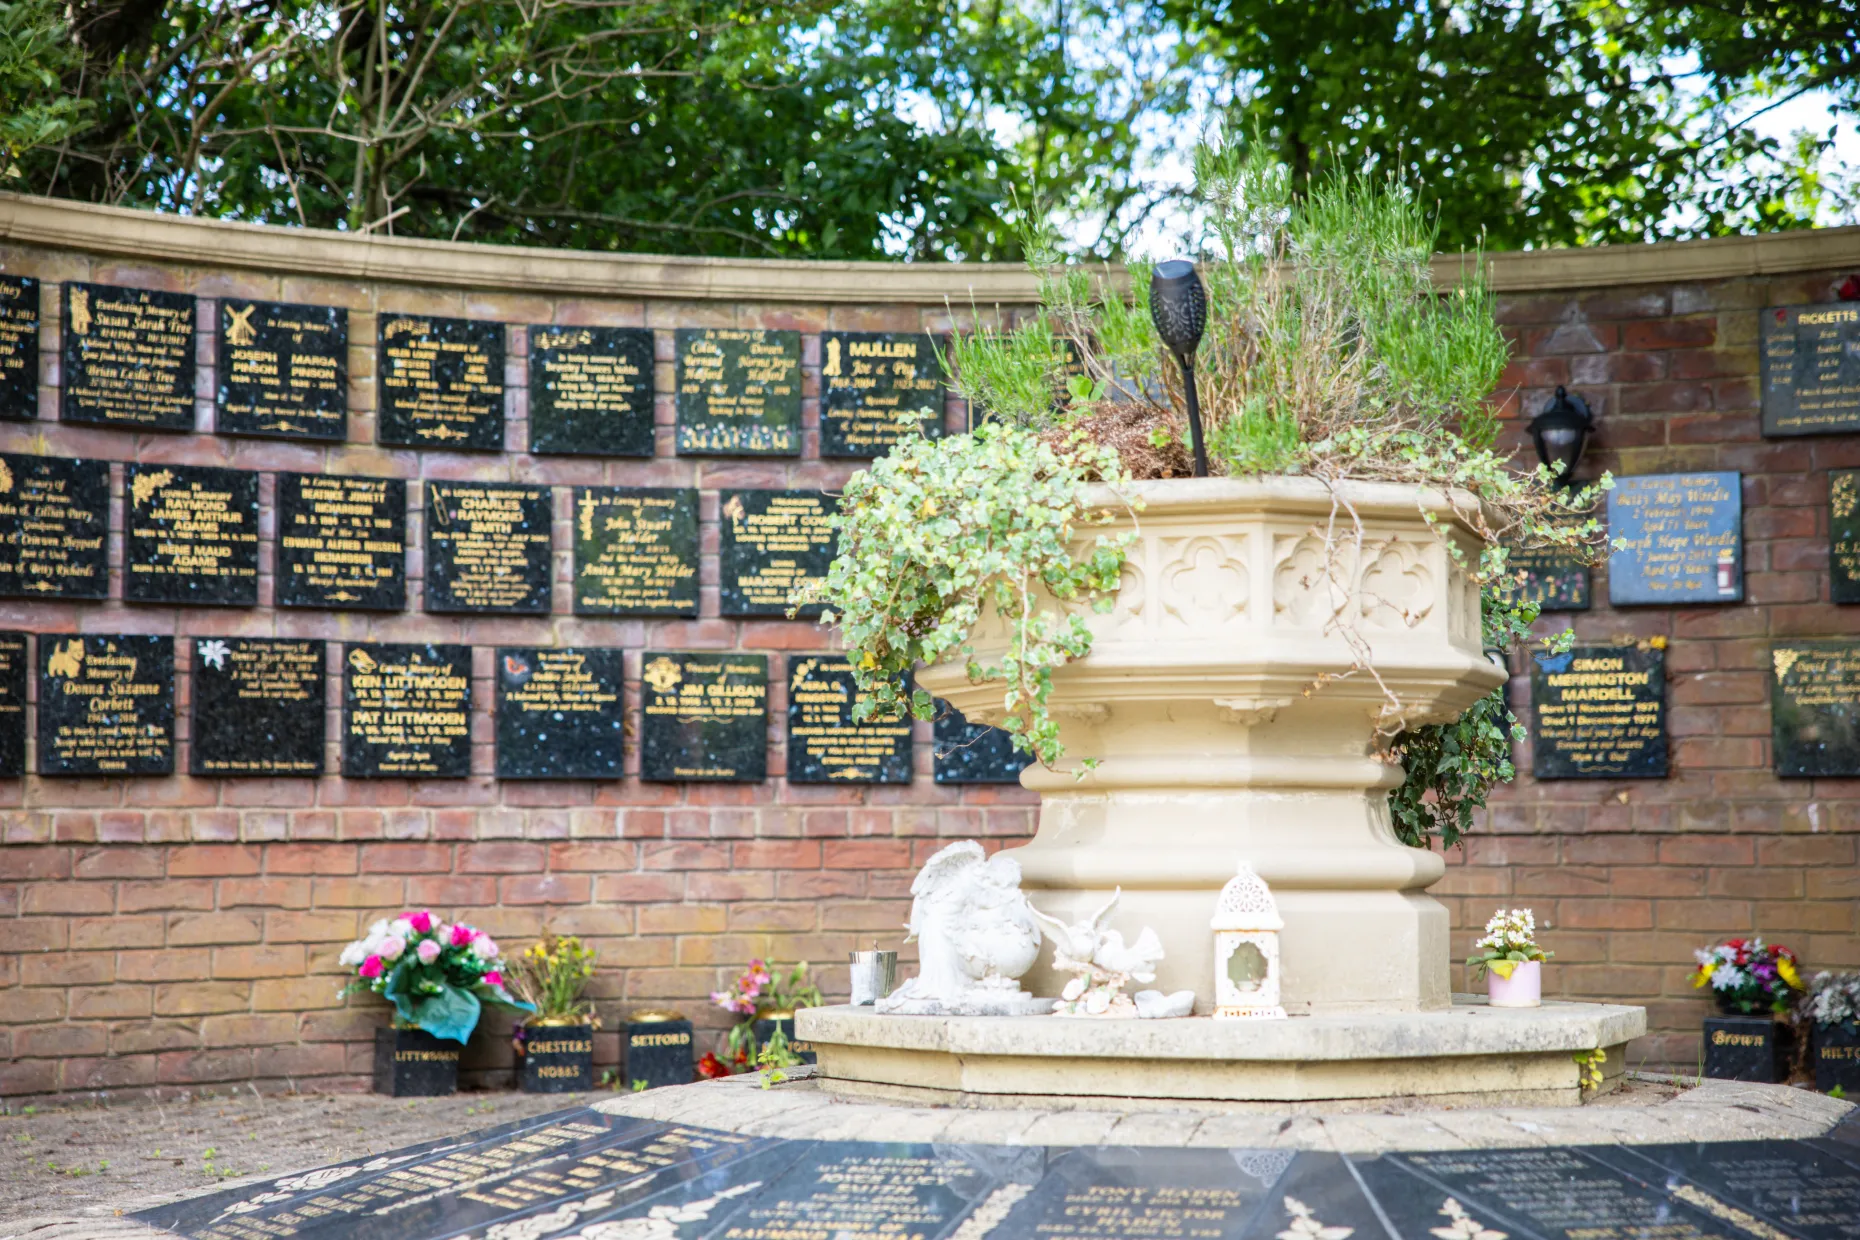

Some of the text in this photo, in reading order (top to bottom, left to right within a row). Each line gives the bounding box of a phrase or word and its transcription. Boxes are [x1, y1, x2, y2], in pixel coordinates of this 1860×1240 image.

[95, 299, 144, 316] Everlasting
[145, 304, 179, 319] Memory
[95, 312, 192, 334] Susan Sarah Tree
[1798, 310, 1858, 325] RICKETTS
[231, 349, 278, 363] JOSEPH
[849, 342, 917, 358] MULLEN
[233, 361, 278, 375] PINSON
[291, 366, 336, 380] PINSON
[850, 359, 873, 377] Joe
[152, 369, 176, 383] Tree
[193, 490, 233, 501] MEMORY
[1655, 491, 1682, 507] May
[1686, 487, 1730, 502] Wardle
[165, 498, 228, 511] RAYMOND
[314, 501, 374, 516] RICHARDSON
[461, 498, 521, 511] CHARLES
[149, 507, 243, 523] JAMES ARTHUR
[457, 509, 524, 523] RAYMOND
[747, 514, 798, 526] ROBERT
[174, 520, 220, 533] ADAMS
[471, 521, 512, 534] SMITH
[604, 515, 632, 532] John
[282, 536, 403, 553] EDWARD ALFRED RUSSELL
[1693, 528, 1737, 546] Wardle
[157, 543, 233, 558] IRENE MAUD
[313, 551, 373, 565] RICHARDSON
[172, 555, 218, 568] ADAMS
[618, 563, 653, 581] Mary
[85, 653, 137, 671] Everlasting
[1572, 657, 1623, 672] SIMON
[86, 667, 122, 682] Memory
[1547, 671, 1649, 687] MERRINGTON
[63, 680, 161, 697] Donna Suzanne
[352, 675, 467, 690] KEN LITTMODEN
[801, 681, 830, 692] VERA
[680, 684, 765, 698] JIM GILLIGAN
[1561, 687, 1636, 702] MARDELL
[90, 696, 135, 713] Corbett
[1539, 703, 1565, 714] Born
[1579, 702, 1633, 713] November
[1635, 701, 1659, 711] 1971
[352, 711, 466, 725] PAT LITTMODEN
[1541, 715, 1567, 726] Died
[1576, 714, 1631, 725] December
[1632, 713, 1657, 724] 1971
[631, 1033, 691, 1048] SETFORD
[1711, 1029, 1765, 1047] Brown
[527, 1040, 593, 1054] CHESTERS
[1087, 1185, 1240, 1200] TONY HADEN
[1064, 1205, 1226, 1220] CYRIL VICTOR
[1095, 1216, 1181, 1229] HADEN
